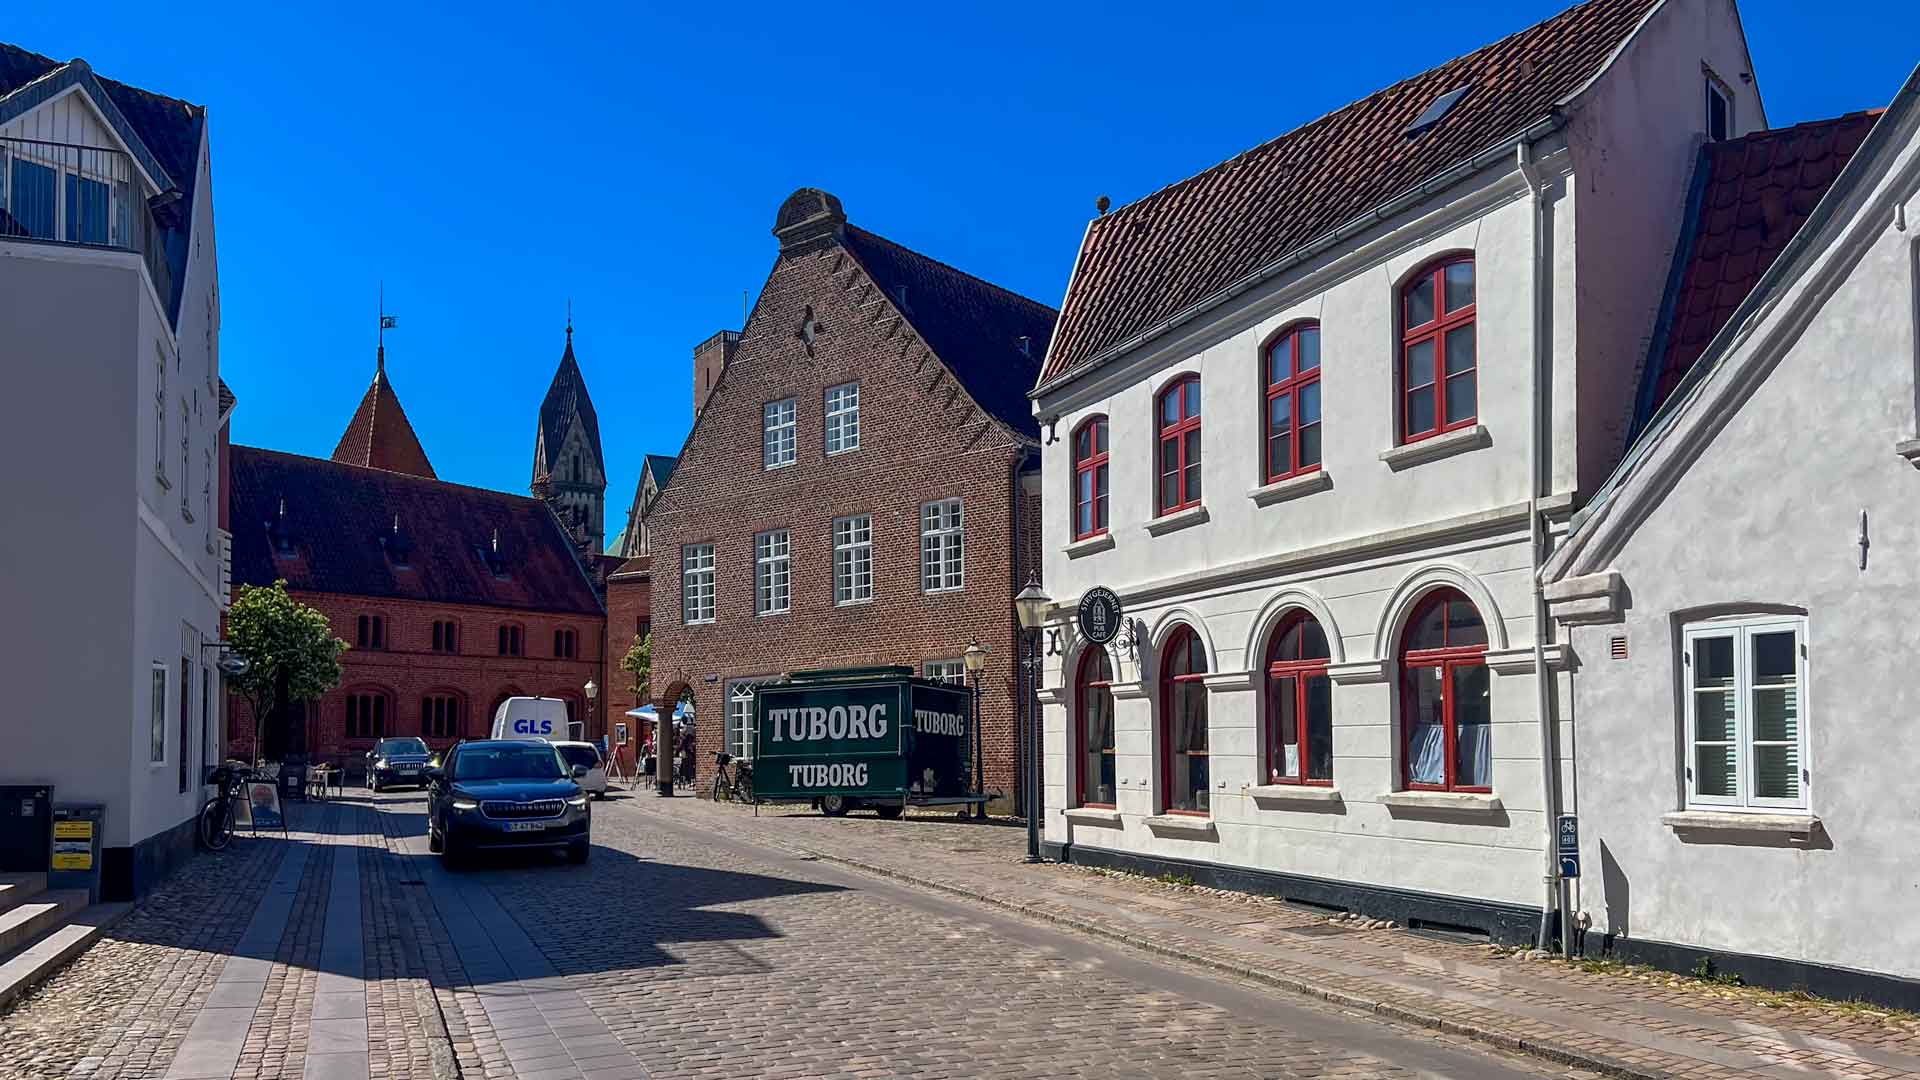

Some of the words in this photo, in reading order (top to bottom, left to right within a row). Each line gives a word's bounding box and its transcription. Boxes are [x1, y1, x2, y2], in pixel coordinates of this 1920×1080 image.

[1081, 590, 1119, 613] STRYGEJERNET
[514, 719, 552, 735] GLS
[768, 704, 888, 742] TUBORG
[915, 709, 964, 737] TUBORG
[789, 763, 868, 788] TUBORG
